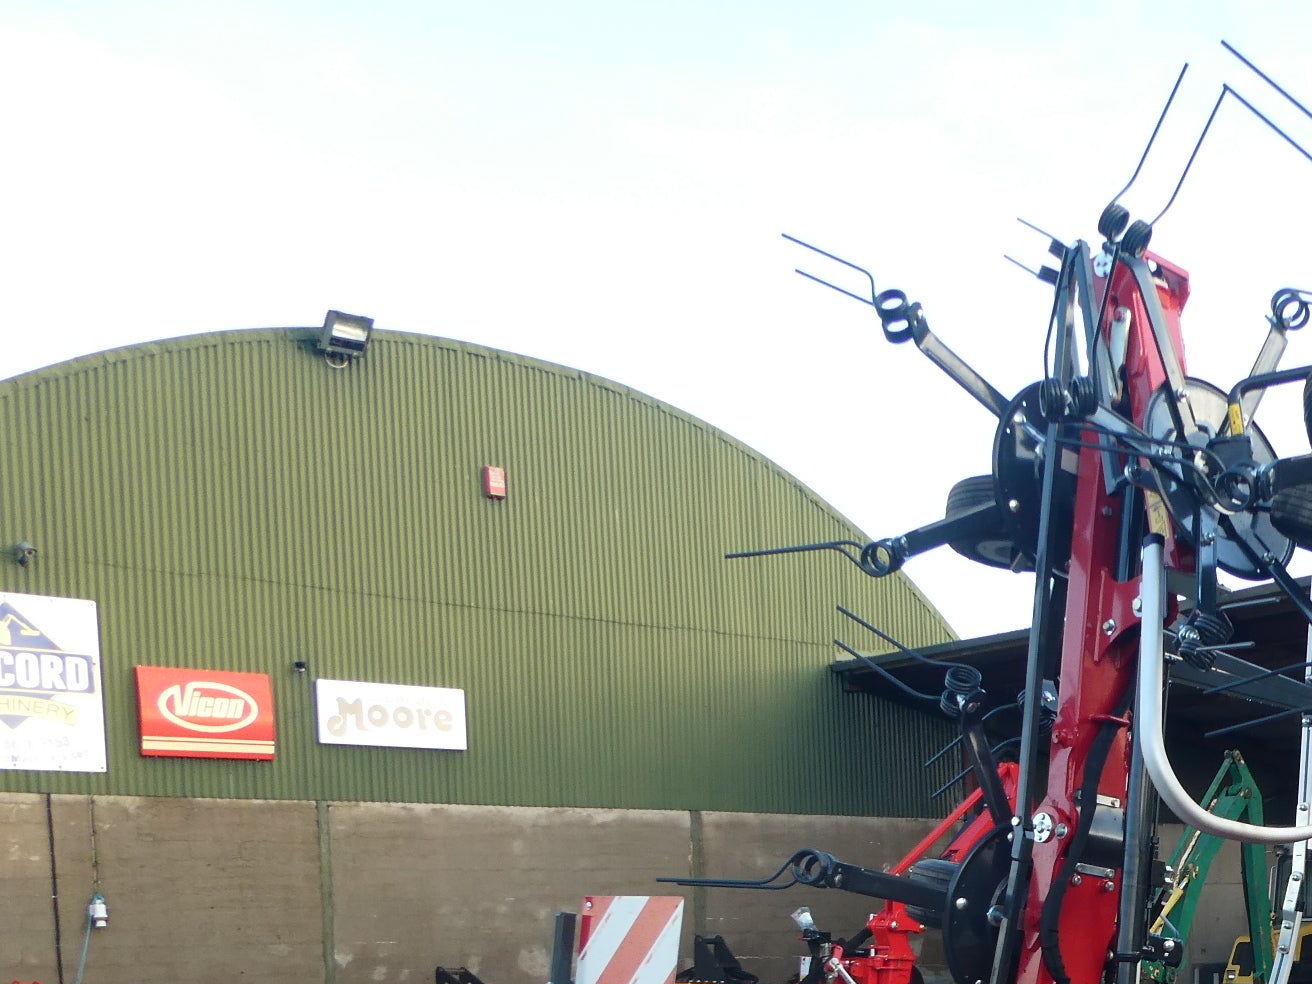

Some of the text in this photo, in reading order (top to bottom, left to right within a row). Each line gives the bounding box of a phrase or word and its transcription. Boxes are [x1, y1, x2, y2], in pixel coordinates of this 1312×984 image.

[0, 651, 90, 692] CORD
[171, 682, 246, 720] Vicon
[327, 696, 454, 737] Moore
